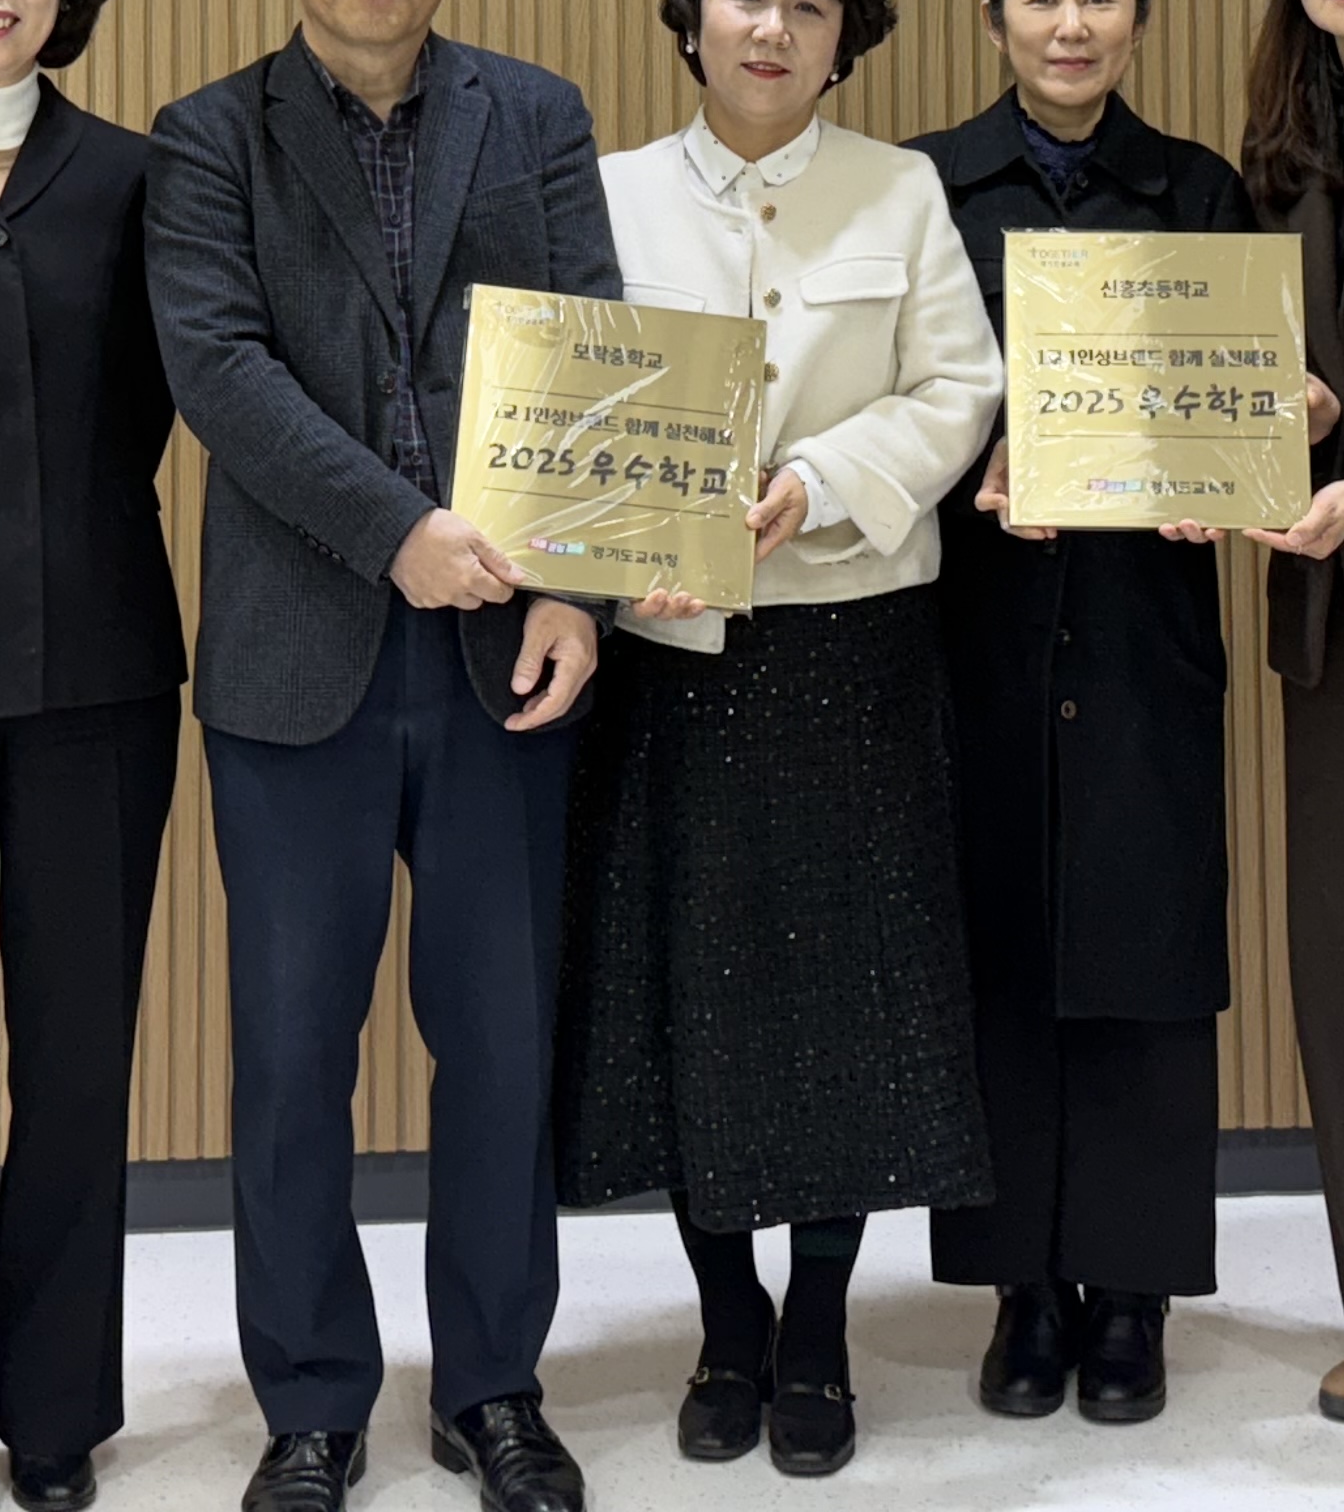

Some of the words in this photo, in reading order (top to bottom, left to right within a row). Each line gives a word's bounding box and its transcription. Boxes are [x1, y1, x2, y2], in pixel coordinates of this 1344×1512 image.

[1100, 279, 1210, 300] 신흥초등학교
[572, 343, 664, 370] 모락중학교
[1168, 349, 1203, 367] 함께
[1208, 349, 1279, 367] 실천해요
[1038, 388, 1125, 415] 2025
[1139, 384, 1277, 423] 우수학교
[624, 418, 660, 438] 함께
[664, 423, 735, 447] 실천해요
[488, 443, 576, 476] 2025
[590, 450, 729, 497] 우수학교
[591, 544, 679, 568] 경기도교육청
